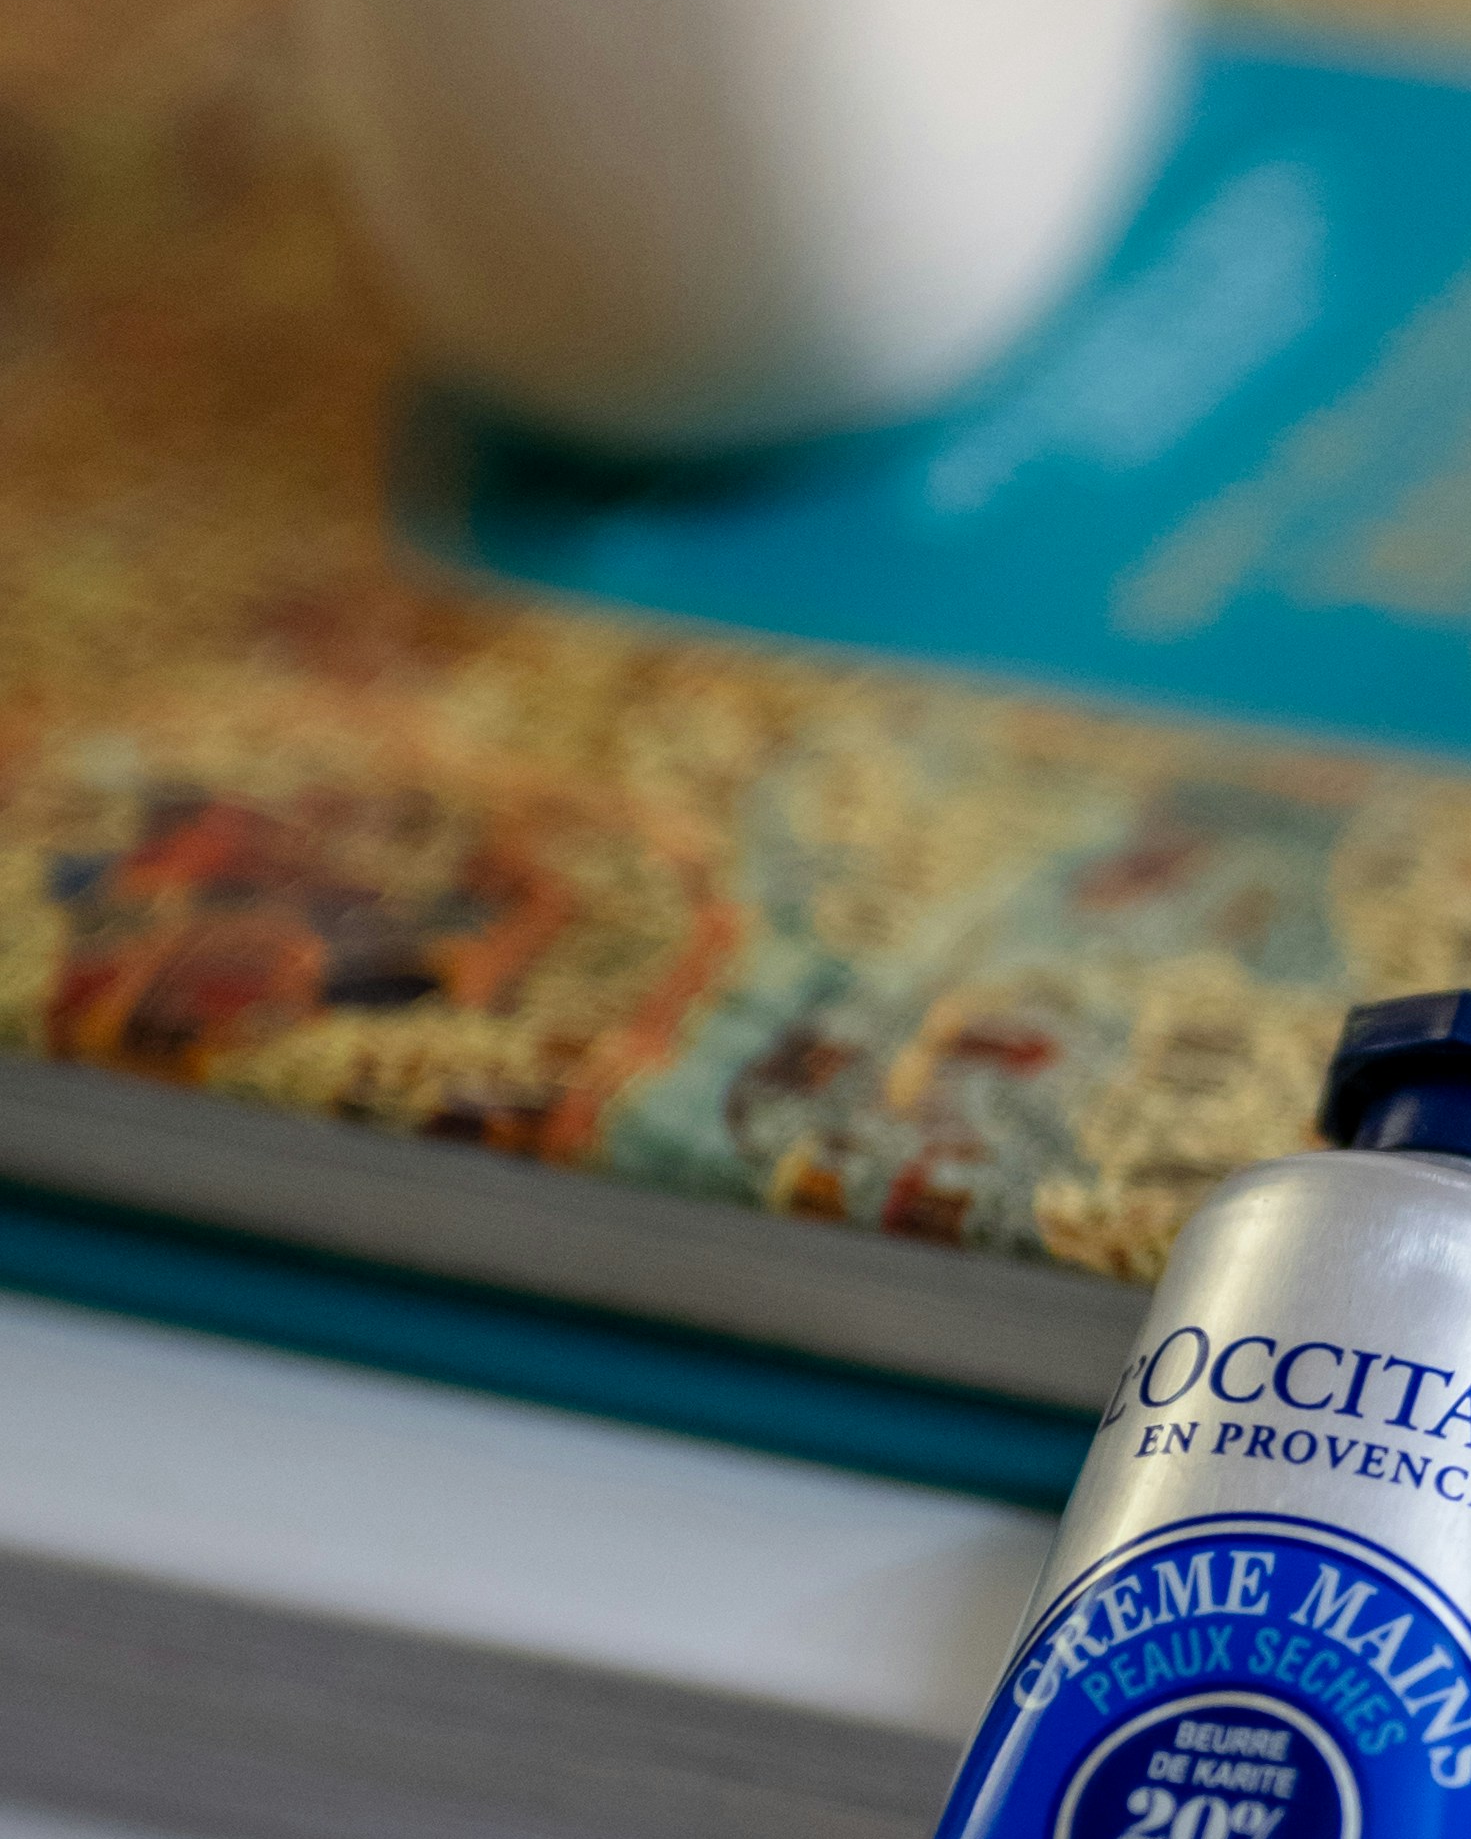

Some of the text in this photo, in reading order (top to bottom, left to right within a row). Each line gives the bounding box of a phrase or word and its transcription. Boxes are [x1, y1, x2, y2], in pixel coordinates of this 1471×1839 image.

[1135, 1422, 1200, 1458] EN
[1080, 1624, 1234, 1715] PEAUX
[1174, 1719, 1292, 1762] BEURRE
[1147, 1751, 1298, 1800] DE KARITE
